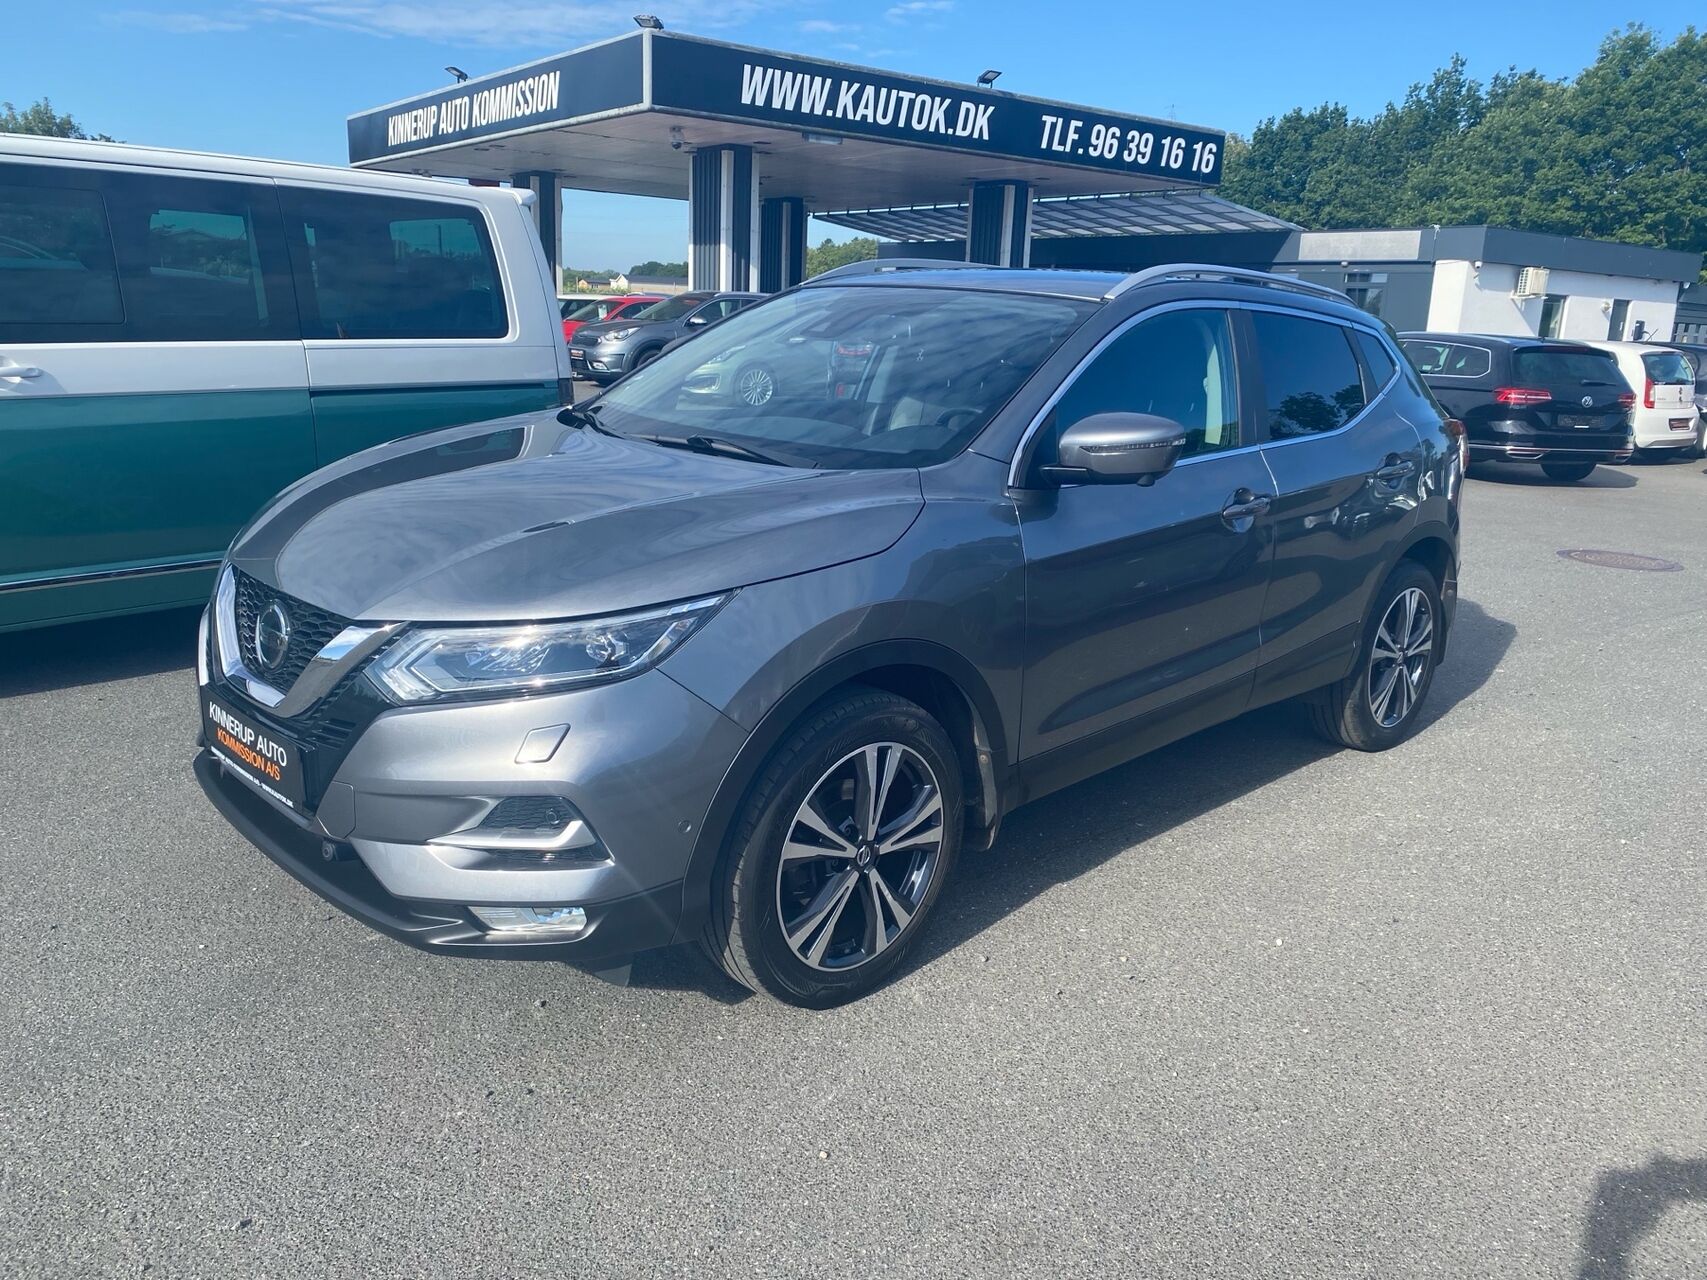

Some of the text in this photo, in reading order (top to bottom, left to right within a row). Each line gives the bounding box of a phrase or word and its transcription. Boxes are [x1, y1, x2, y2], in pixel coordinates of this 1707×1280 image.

[388, 71, 560, 147] KINNERUP AUTO KOMMISSION
[740, 64, 996, 141] WWW.KAUTOK.DK
[1040, 115, 1217, 174] TLF. 96 39 16 16
[209, 701, 287, 767] KINNERUP AUTO
[217, 727, 265, 771] KOMMISSION
[265, 761, 281, 781] A/S
